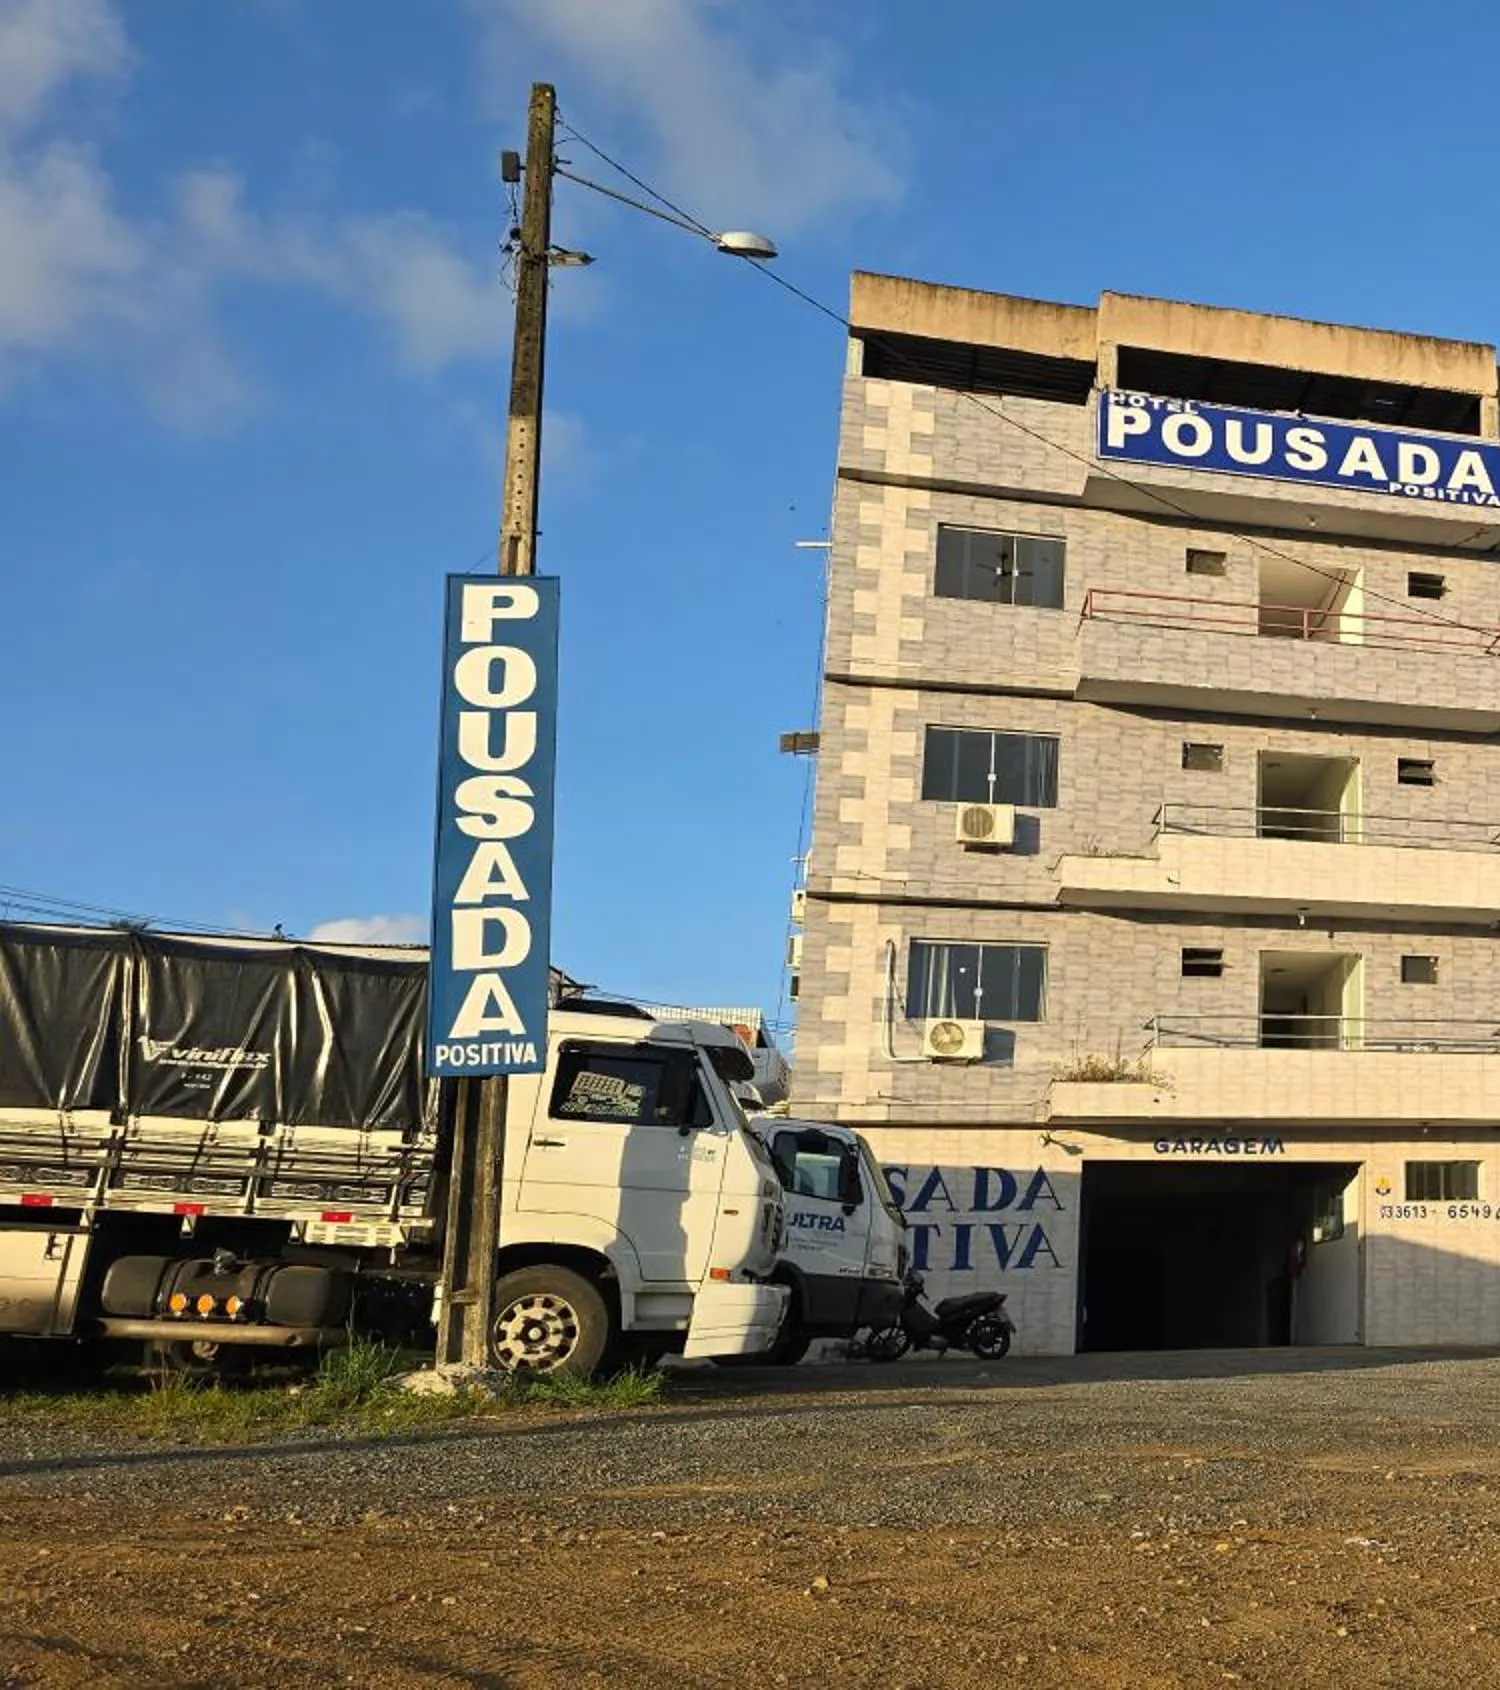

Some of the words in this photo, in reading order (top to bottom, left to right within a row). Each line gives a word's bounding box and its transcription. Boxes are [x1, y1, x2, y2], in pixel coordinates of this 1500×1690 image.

[1108, 393, 1199, 416] HOTEL
[1107, 407, 1496, 494] POUSADA
[449, 583, 540, 1039] POUSADA
[435, 1042, 537, 1067] POSITIVA
[1153, 1137, 1285, 1155] GARAGEM
